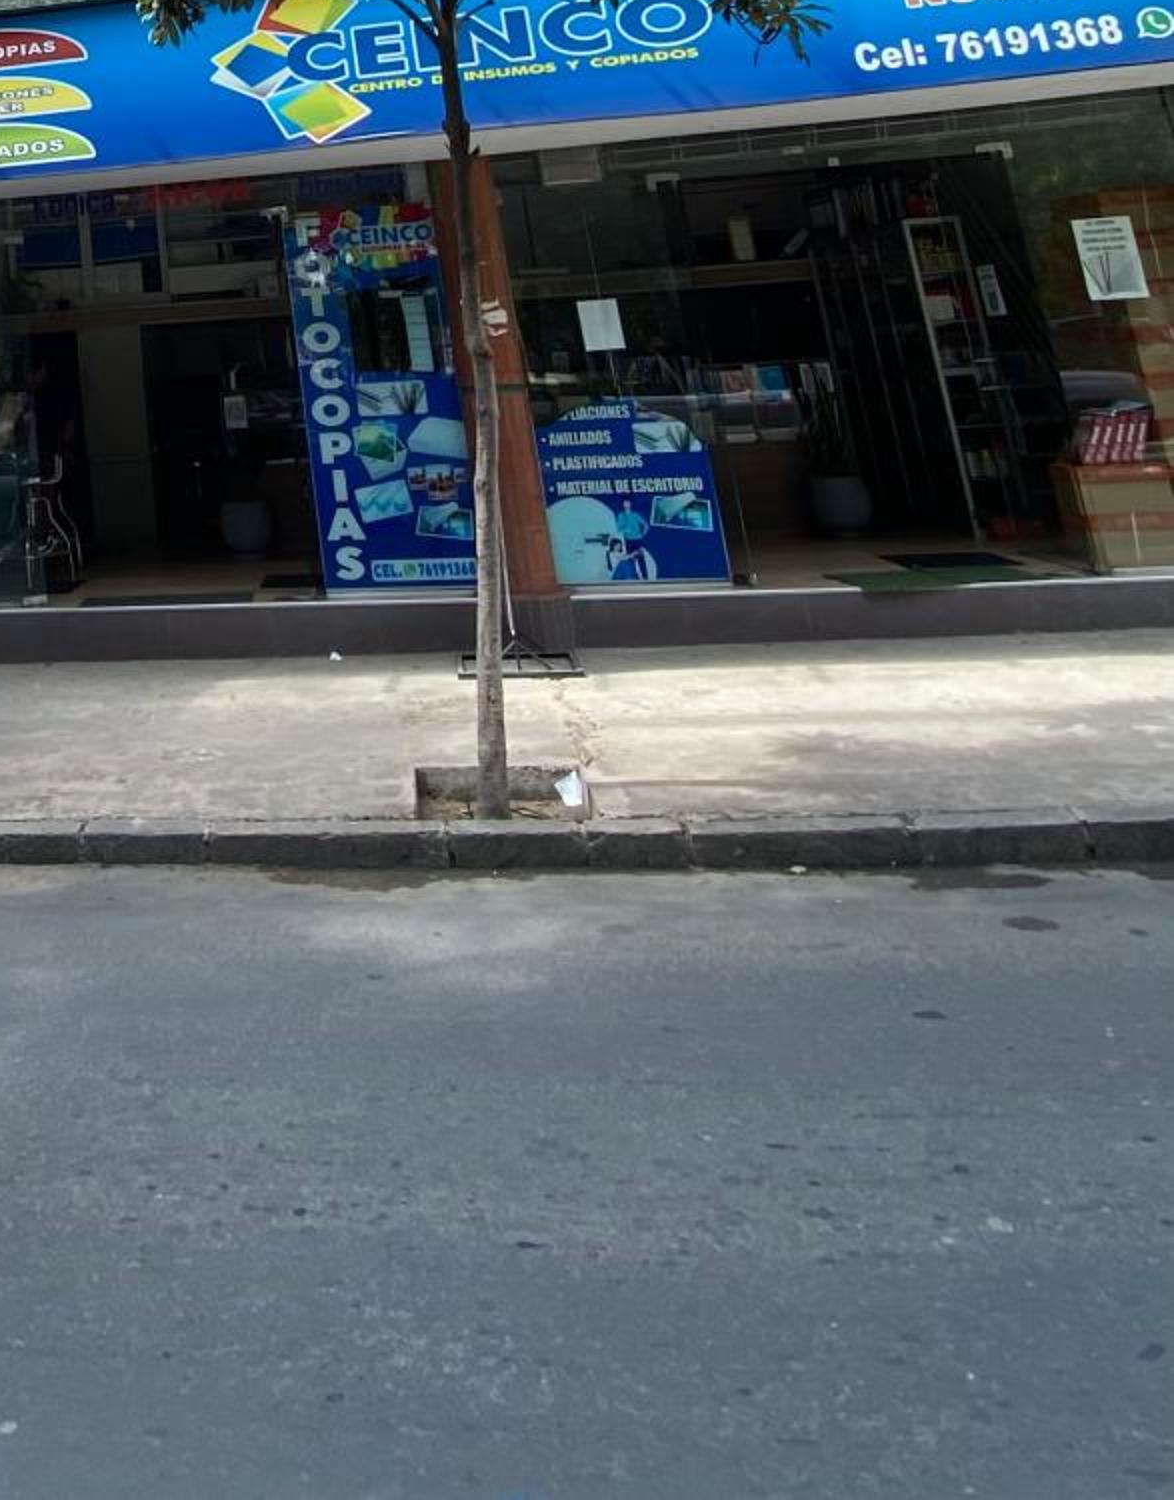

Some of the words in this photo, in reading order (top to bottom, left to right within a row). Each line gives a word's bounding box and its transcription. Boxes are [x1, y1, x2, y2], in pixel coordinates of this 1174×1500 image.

[854, 37, 928, 71] Cel:
[935, 14, 1123, 64] 76191368
[349, 77, 423, 93] CENTRO
[463, 62, 557, 82] INSUMOS
[565, 58, 579, 72] Y
[590, 48, 699, 69] COPIADOS
[346, 224, 432, 245] CEINCO
[294, 214, 366, 581] FOTOCOPIAS
[548, 430, 612, 447] ANILLADOS
[553, 455, 644, 471] PLASTIFICADOS
[556, 480, 613, 496] MATERIAL
[615, 479, 629, 494] DE
[630, 477, 703, 494] ESCRITORIO
[374, 562, 402, 578] CEL.
